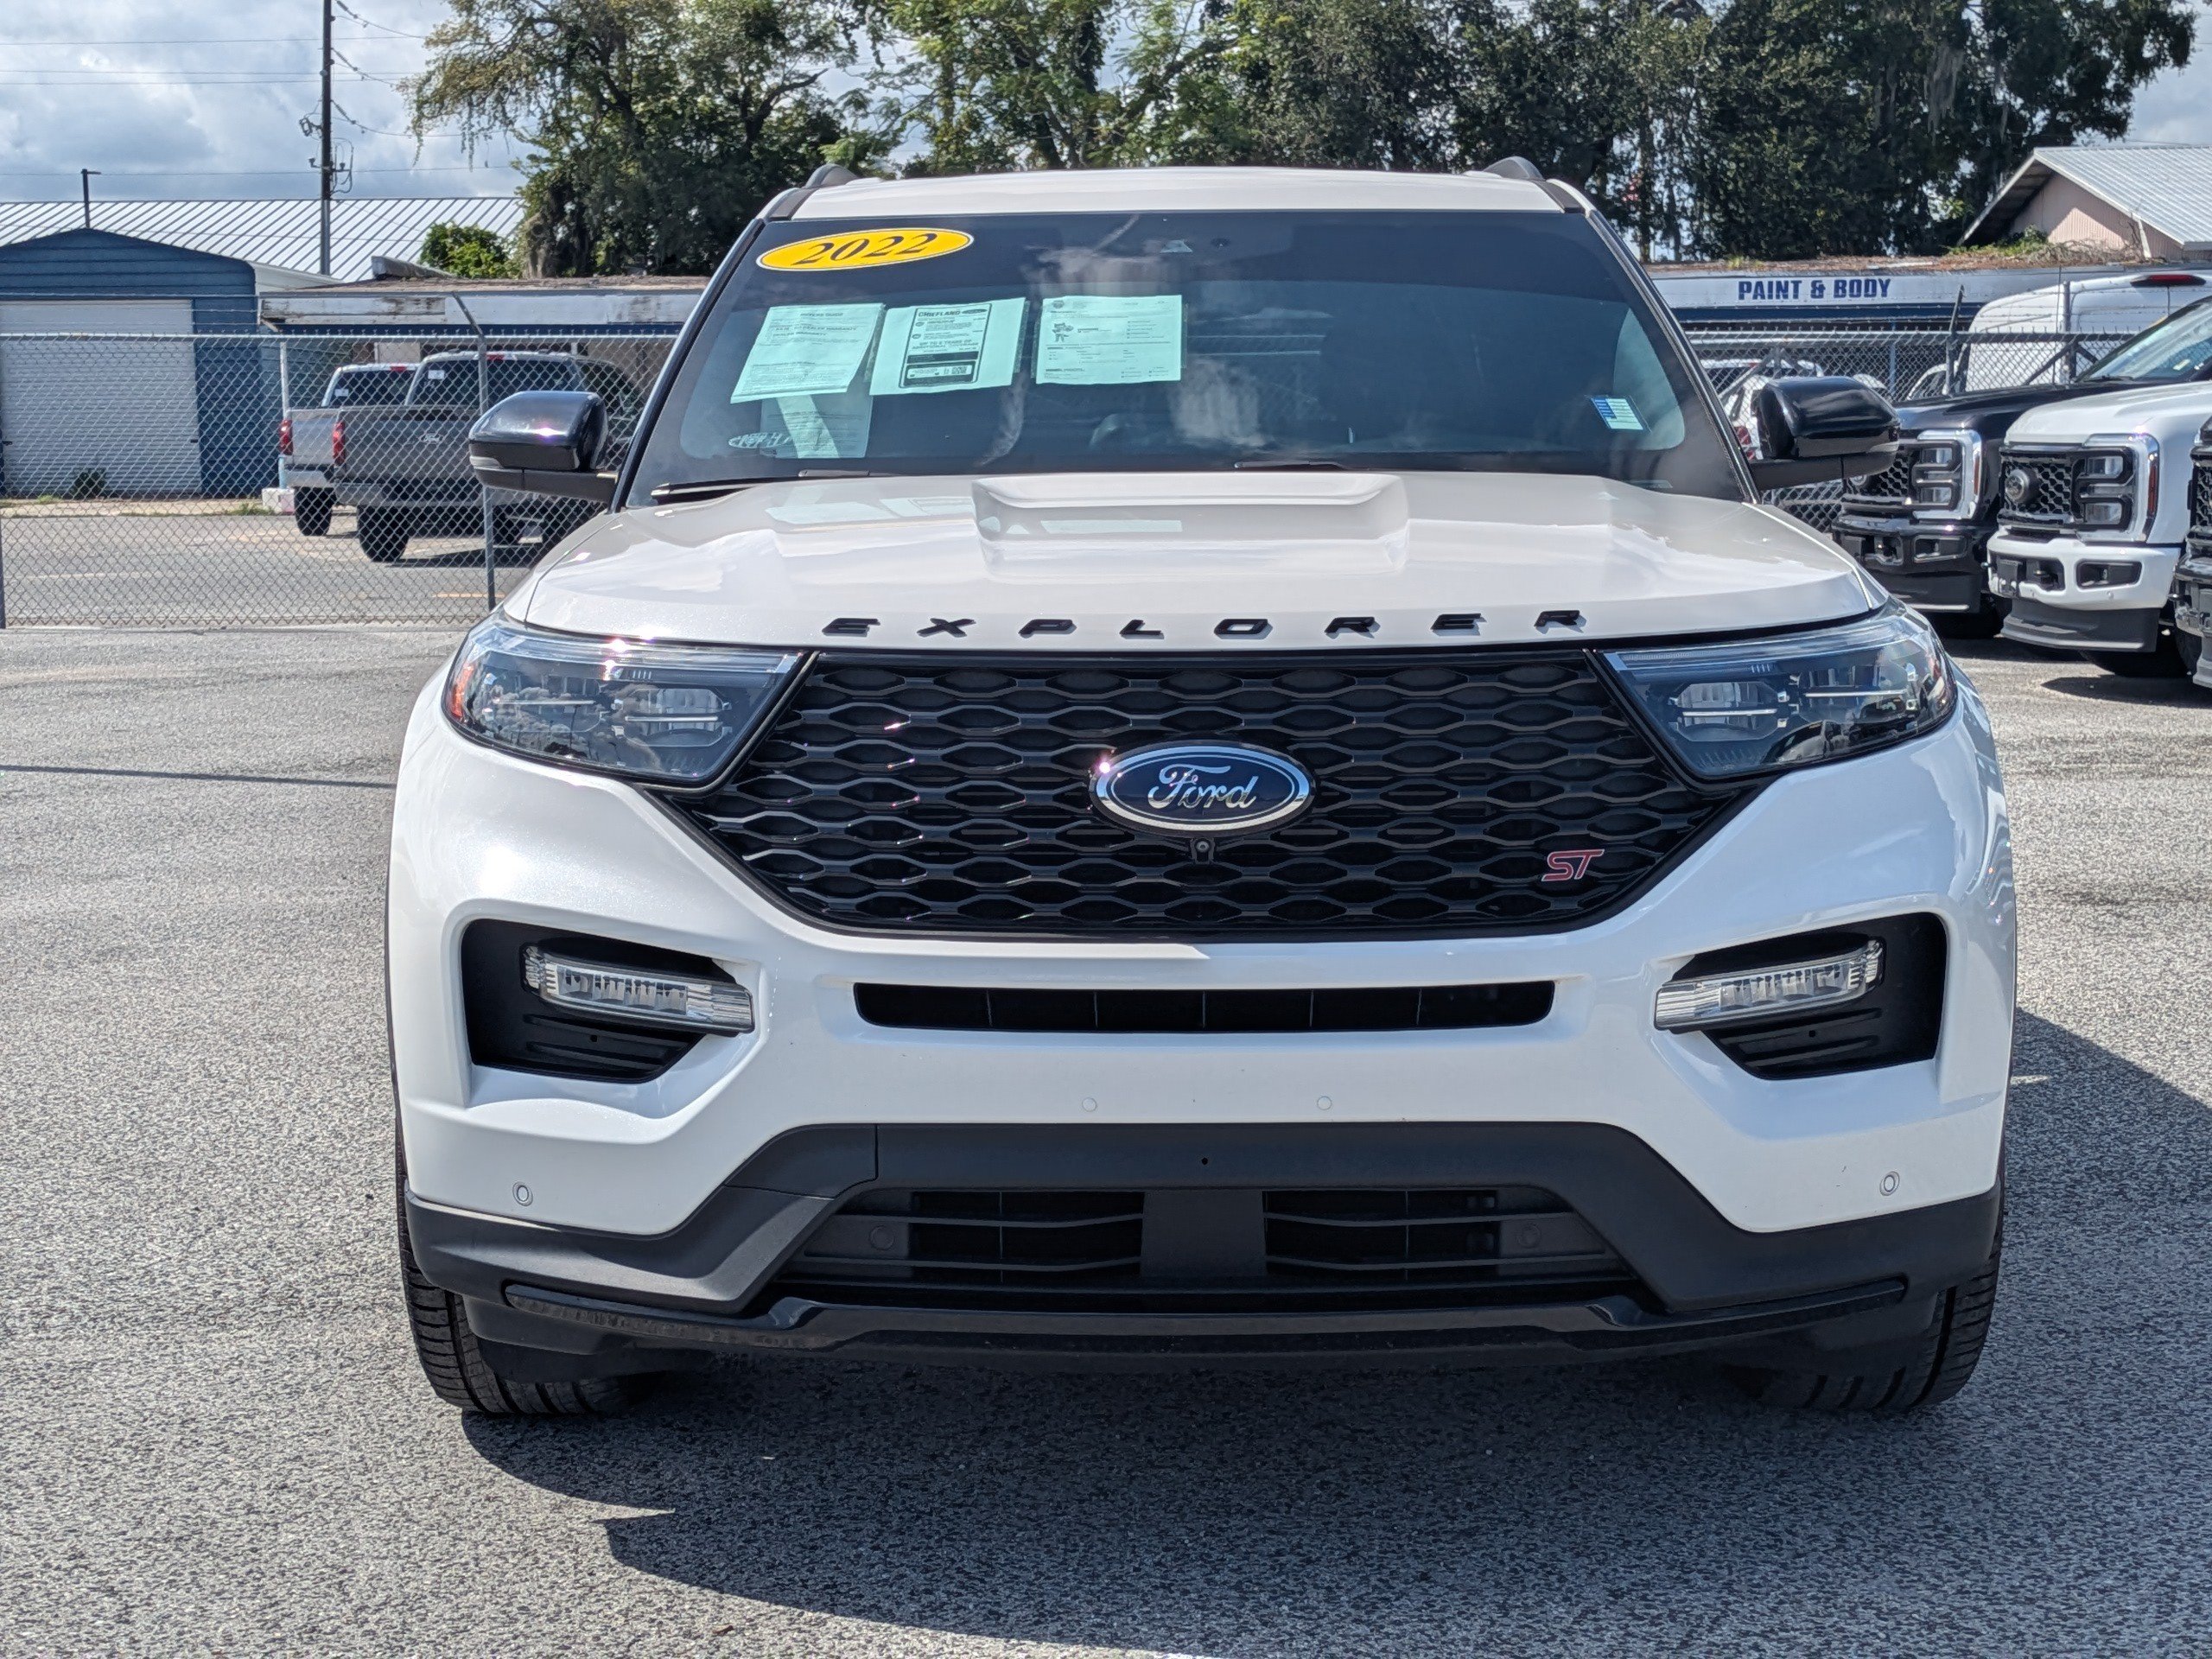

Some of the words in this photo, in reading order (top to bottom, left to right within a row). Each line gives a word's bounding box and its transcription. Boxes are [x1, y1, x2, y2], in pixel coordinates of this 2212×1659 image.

[790, 232, 938, 266] 2022
[1738, 280, 1802, 300] PAINT
[1810, 280, 1826, 299] &
[1834, 278, 1891, 298] BODY
[821, 610, 1581, 638] EXPLORER
[1147, 763, 1259, 809] Ford
[1541, 849, 1605, 881] ST
